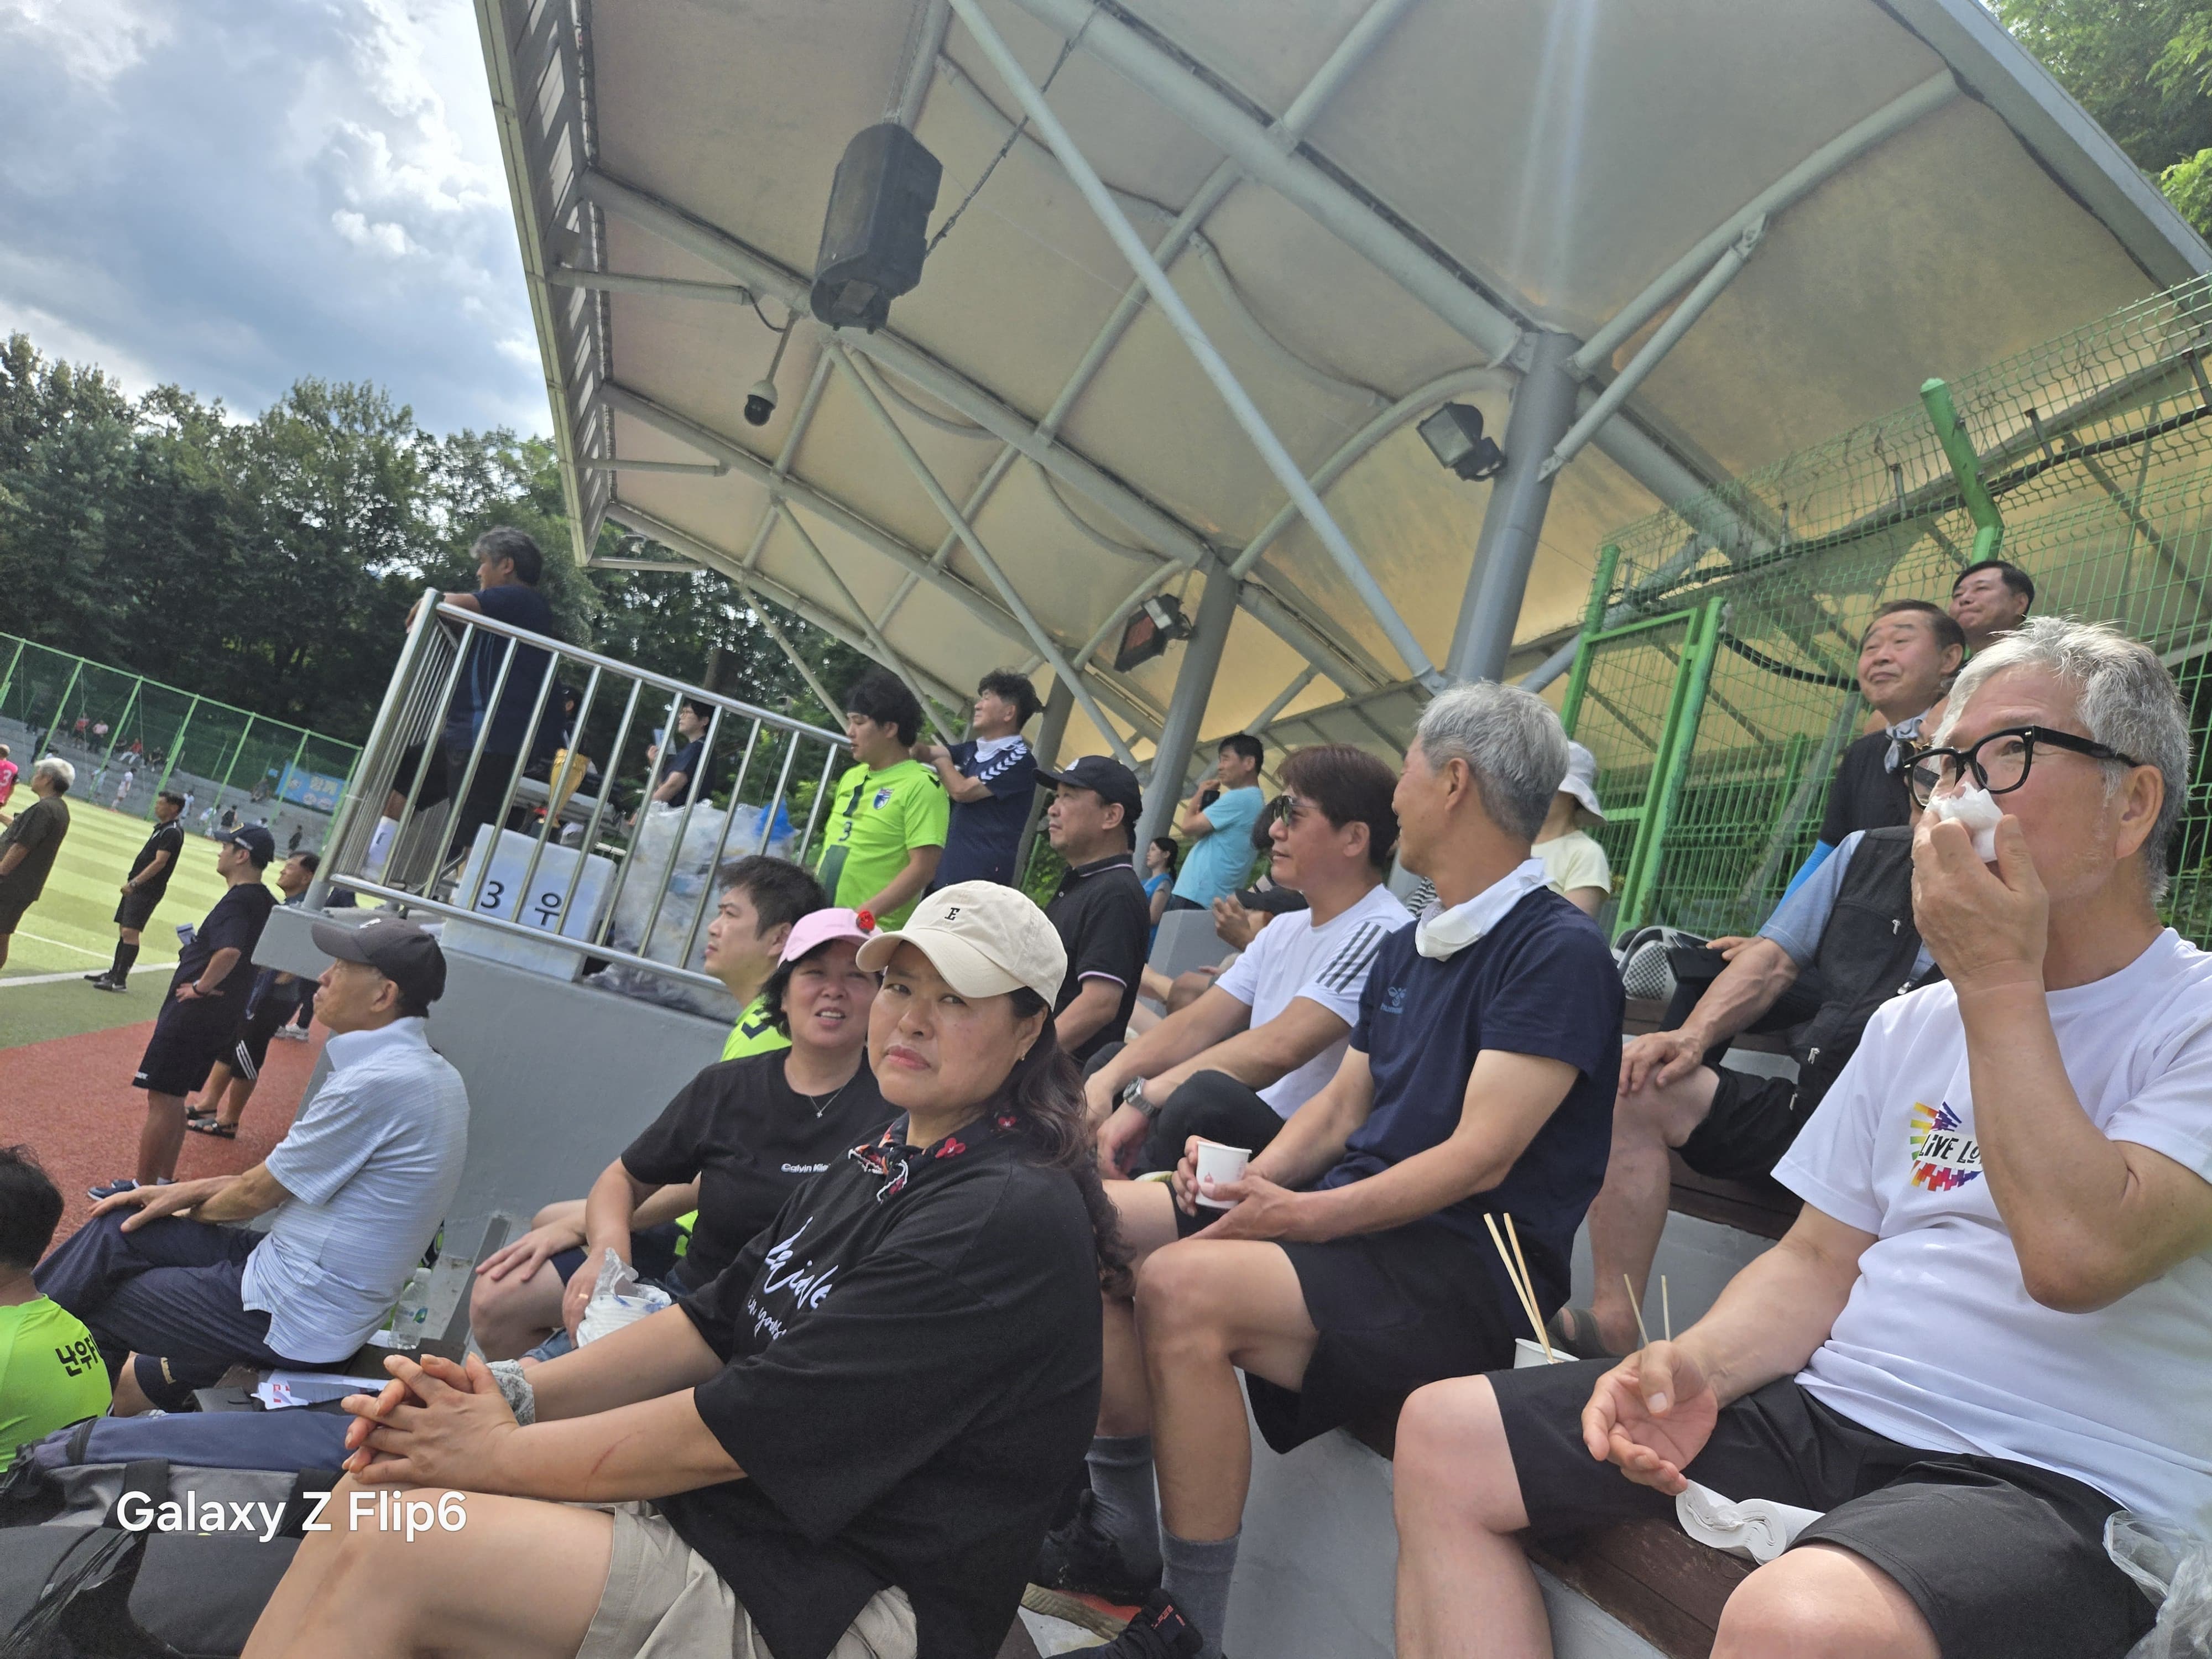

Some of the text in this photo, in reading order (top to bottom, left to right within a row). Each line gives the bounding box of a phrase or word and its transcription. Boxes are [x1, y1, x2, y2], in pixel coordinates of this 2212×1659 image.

[839, 821, 852, 842] 3
[481, 880, 504, 909] 3
[945, 907, 961, 921] E
[781, 1163, 812, 1173] Calvin
